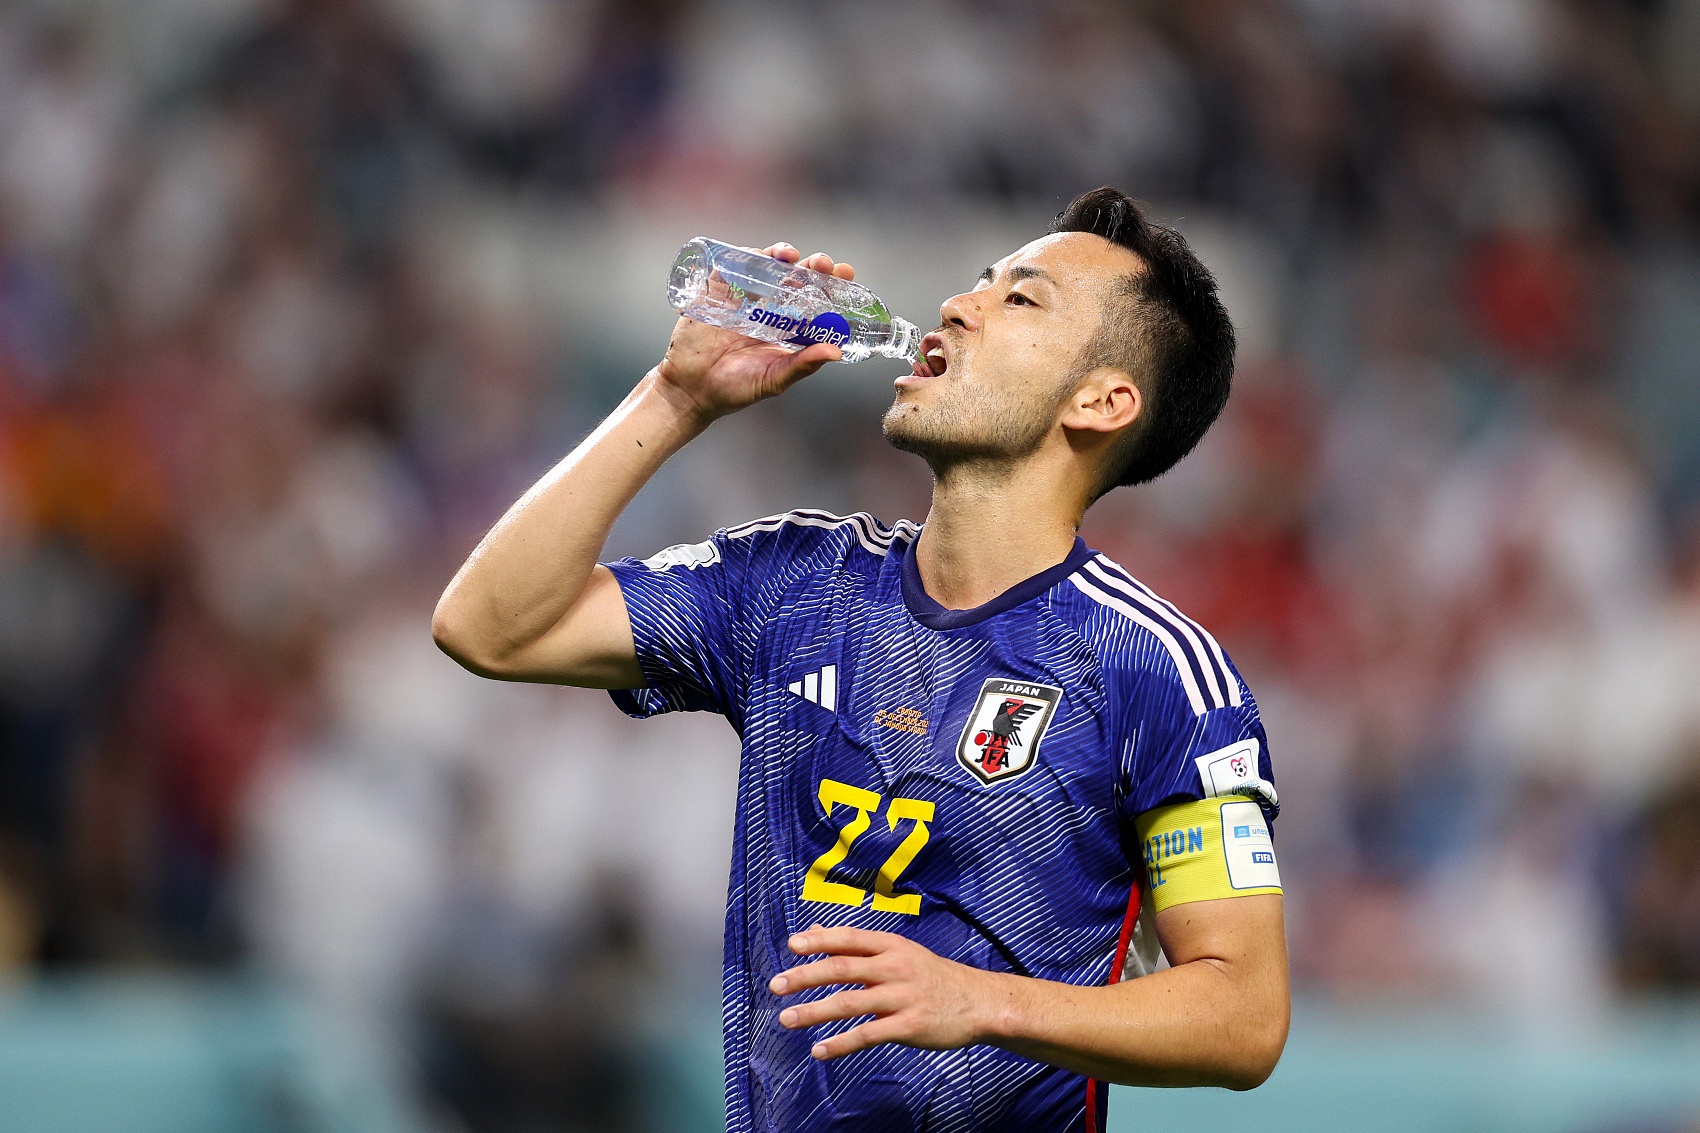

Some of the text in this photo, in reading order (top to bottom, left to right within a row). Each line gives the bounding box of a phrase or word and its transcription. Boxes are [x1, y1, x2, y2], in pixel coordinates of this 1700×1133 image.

[999, 683, 1041, 697] JAPAN
[896, 707, 922, 718] CROATIA
[974, 748, 1010, 768] JFA
[801, 778, 936, 916] 22
[1255, 853, 1272, 862] FIFA
[1149, 863, 1167, 889] LL
